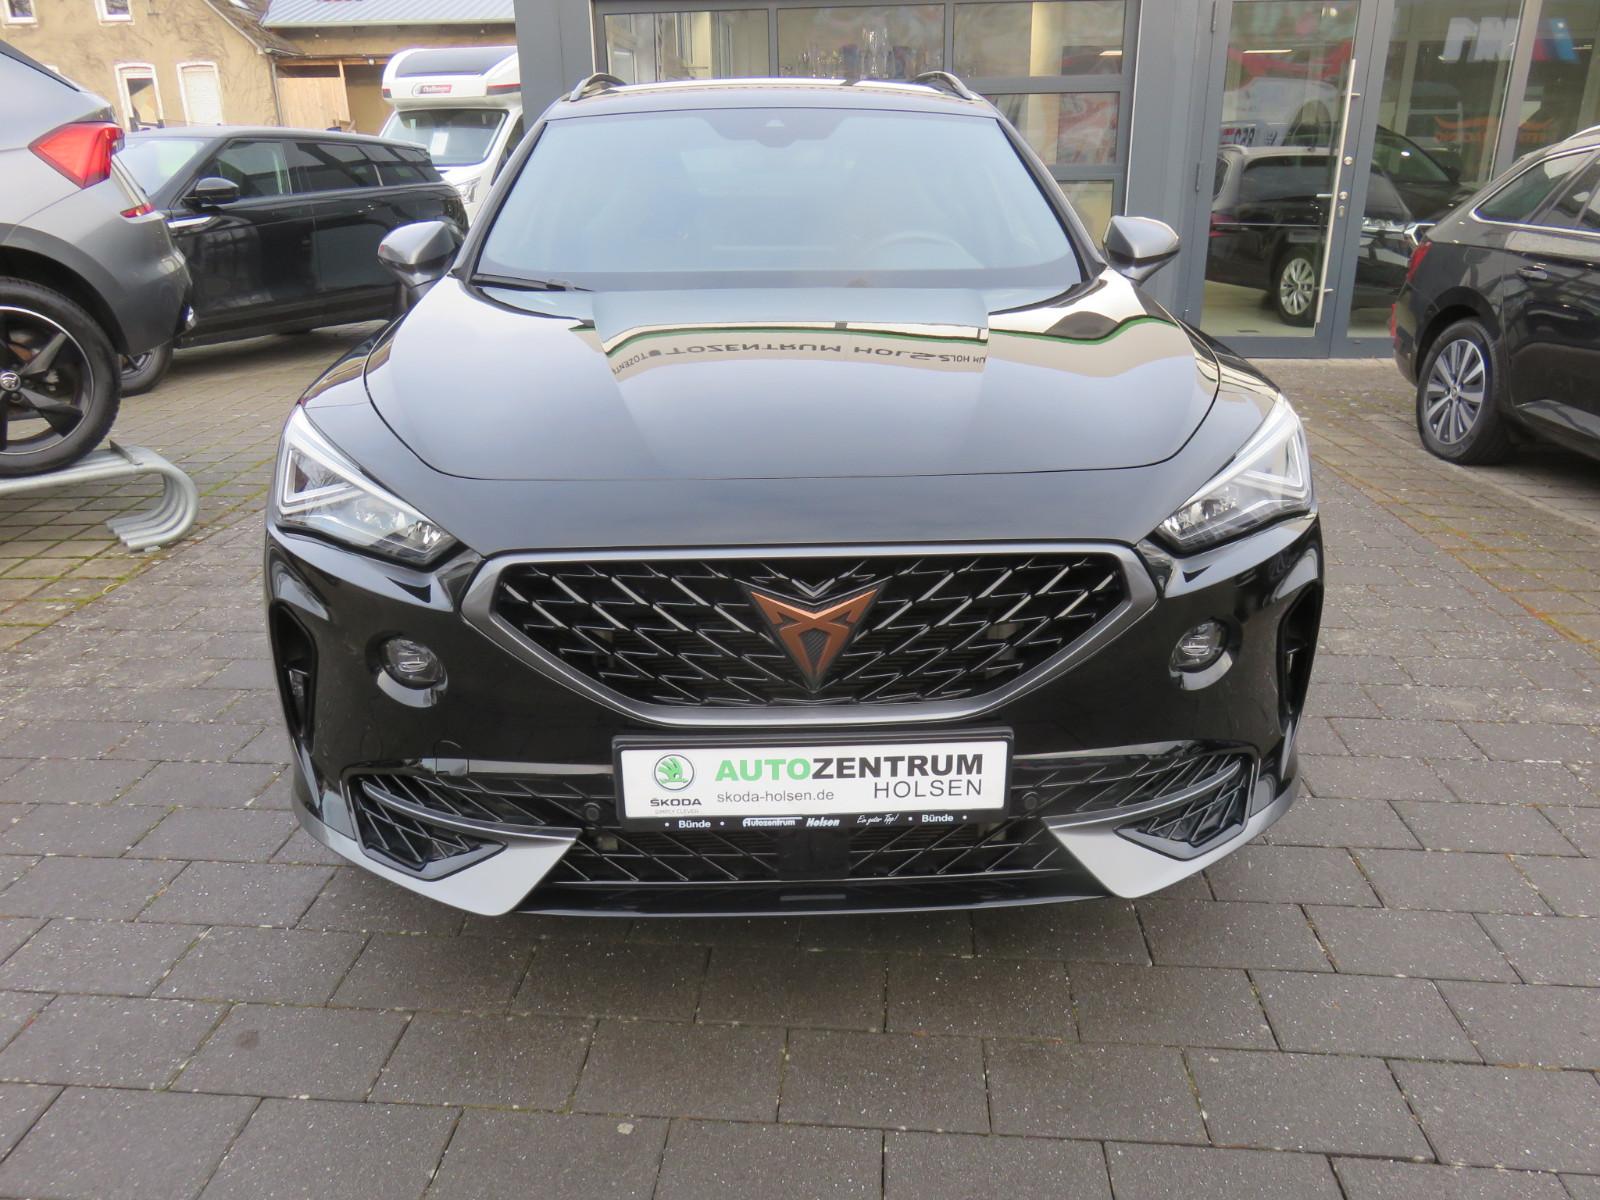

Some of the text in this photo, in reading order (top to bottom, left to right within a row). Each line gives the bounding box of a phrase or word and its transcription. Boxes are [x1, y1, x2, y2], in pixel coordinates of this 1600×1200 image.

[715, 754, 983, 781] AUTOZENTRUM
[716, 789, 834, 803] skoda-holsen.de
[874, 779, 982, 799] HOLSEN
[678, 820, 711, 828] Bünde
[742, 817, 796, 827] Autozentrum
[805, 817, 841, 827] Holsen
[921, 813, 954, 822] Bünde
